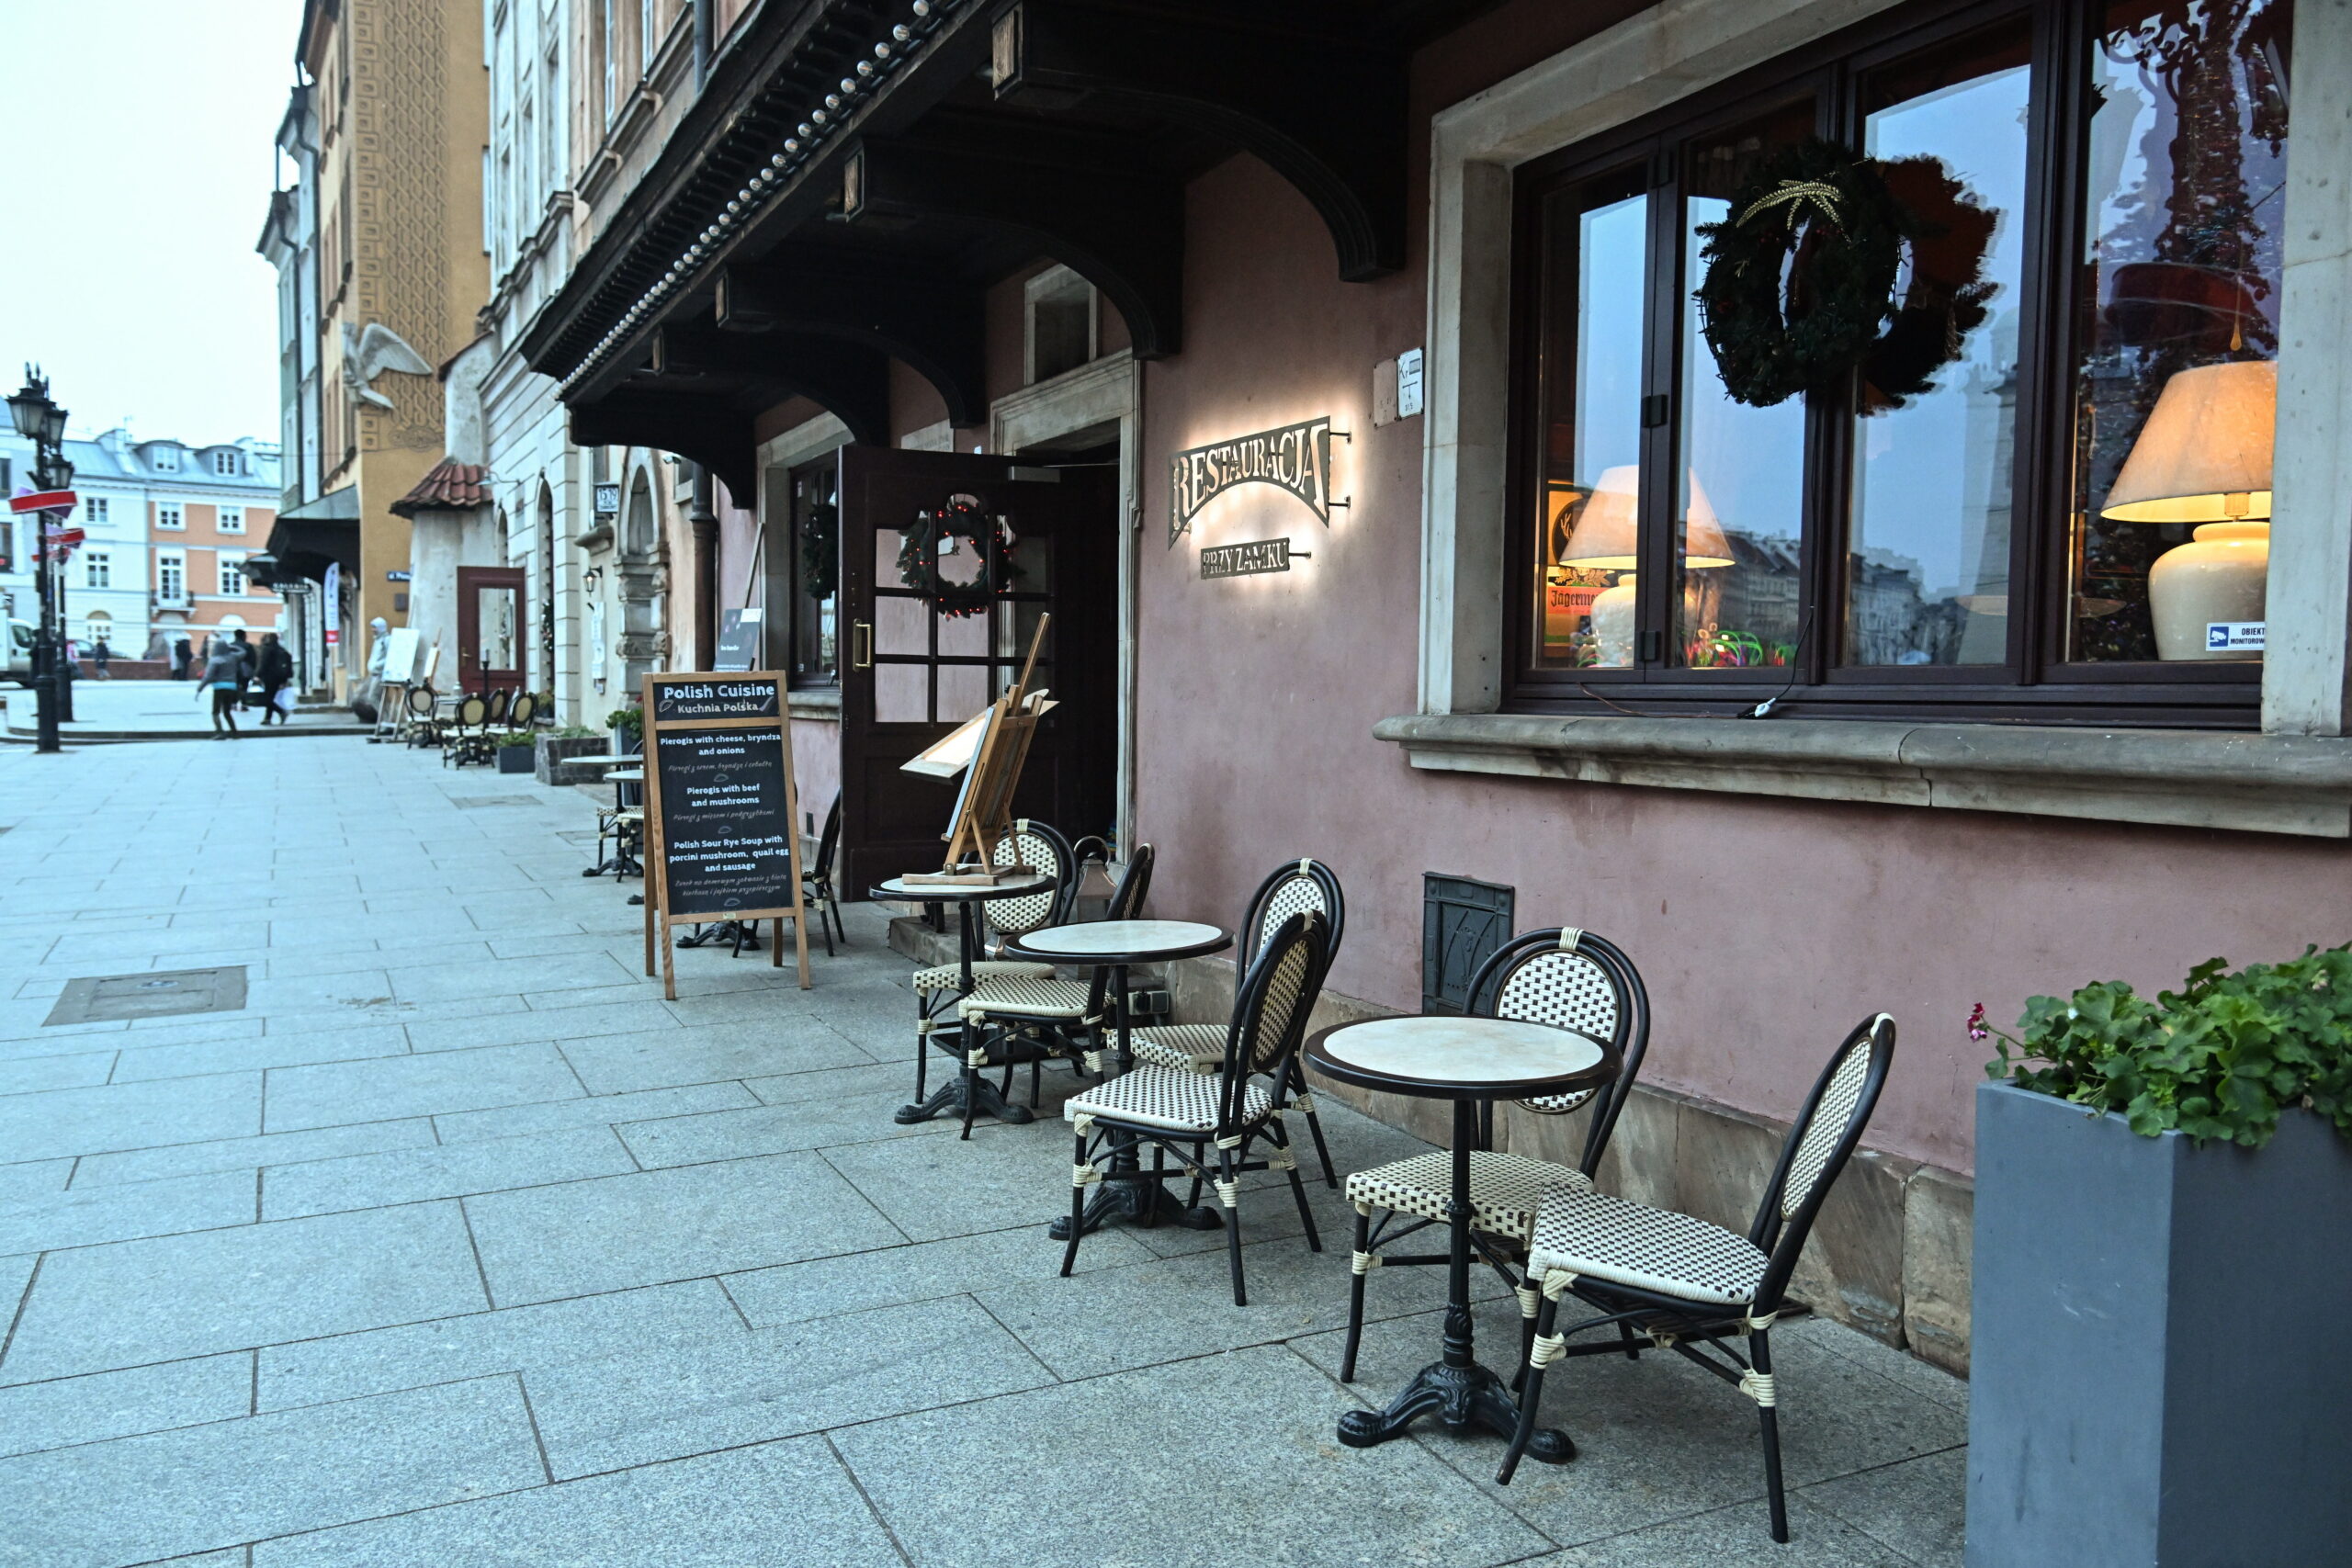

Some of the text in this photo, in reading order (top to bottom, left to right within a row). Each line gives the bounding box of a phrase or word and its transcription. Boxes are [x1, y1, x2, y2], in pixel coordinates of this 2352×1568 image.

[1172, 423, 1329, 530] RESTAURACJA
[1203, 542, 1286, 574] PRZY ZAMKU
[1551, 590, 1599, 607] Jägerme
[2242, 627, 2265, 636] OBIEKT
[663, 683, 775, 699] Polish Cuisine
[677, 702, 759, 714] Kuchnia Polska
[661, 733, 781, 746] Pierogis with cheese, bryndza
[686, 784, 760, 795] Pierogis with beef
[691, 796, 760, 807] and mushrooms
[674, 835, 783, 849] Polish Sour Rye Soup with
[669, 848, 789, 863] porcini mushroom, quail egg
[705, 863, 756, 872] and sausage
